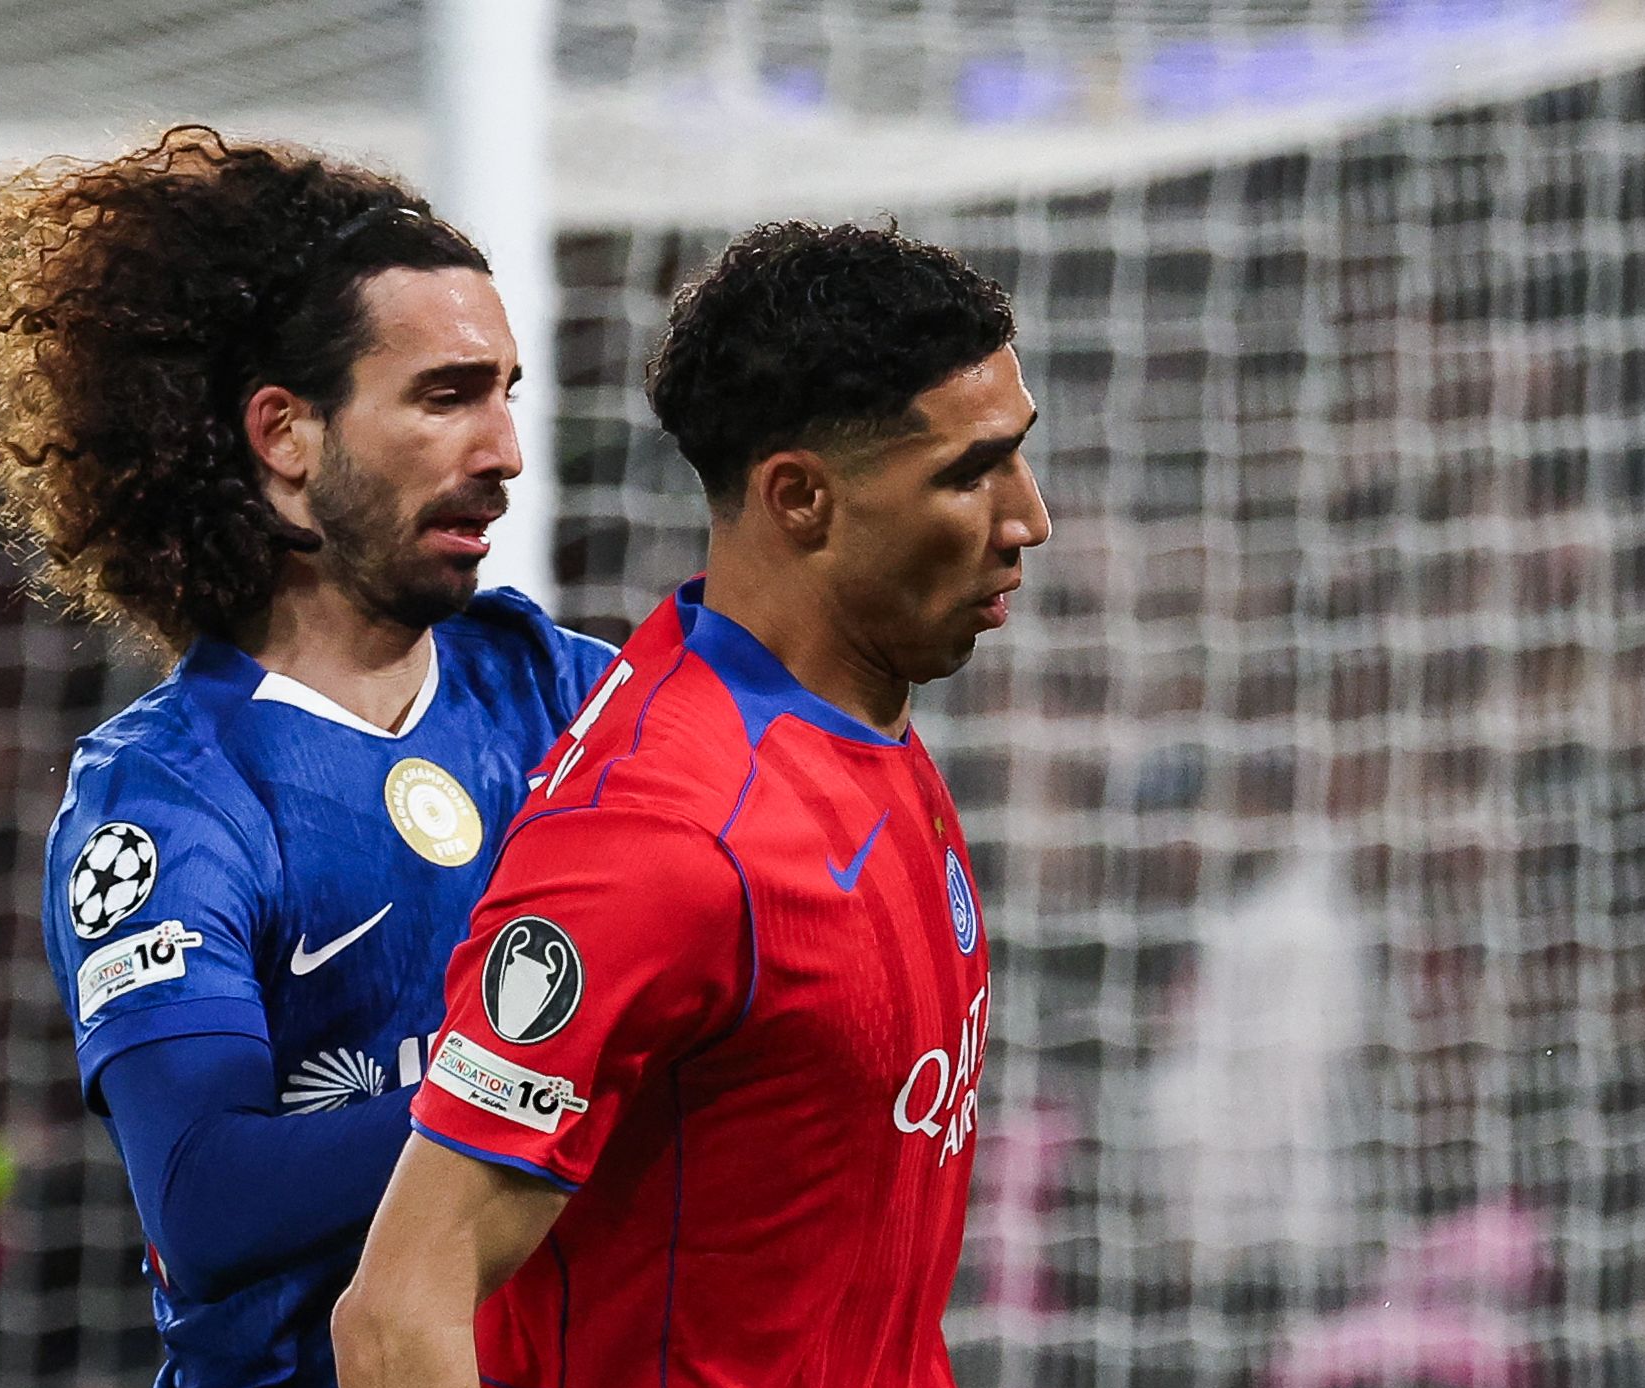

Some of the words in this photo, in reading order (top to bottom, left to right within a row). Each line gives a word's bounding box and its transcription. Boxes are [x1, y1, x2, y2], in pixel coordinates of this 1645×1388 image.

[433, 837, 469, 858] FIFA
[134, 938, 175, 970] 10
[893, 971, 991, 1138] QAT
[438, 1051, 514, 1097] FOUNDATION
[518, 1081, 559, 1115] 10
